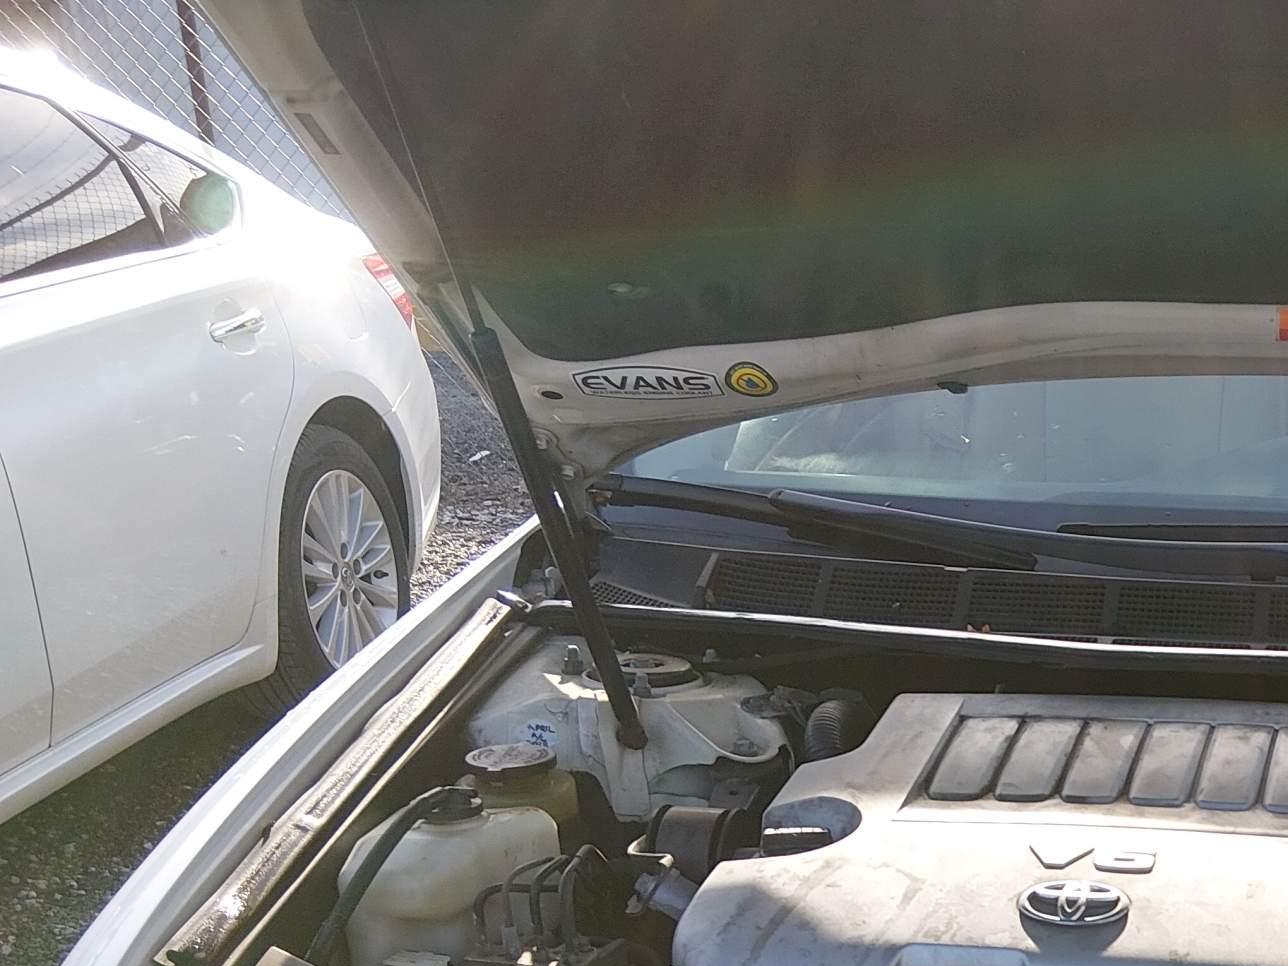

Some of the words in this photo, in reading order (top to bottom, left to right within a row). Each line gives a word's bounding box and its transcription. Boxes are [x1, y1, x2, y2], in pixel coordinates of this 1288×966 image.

[581, 375, 711, 390] EVANS
[528, 724, 555, 733] APRIL
[1028, 843, 1157, 874] V6
